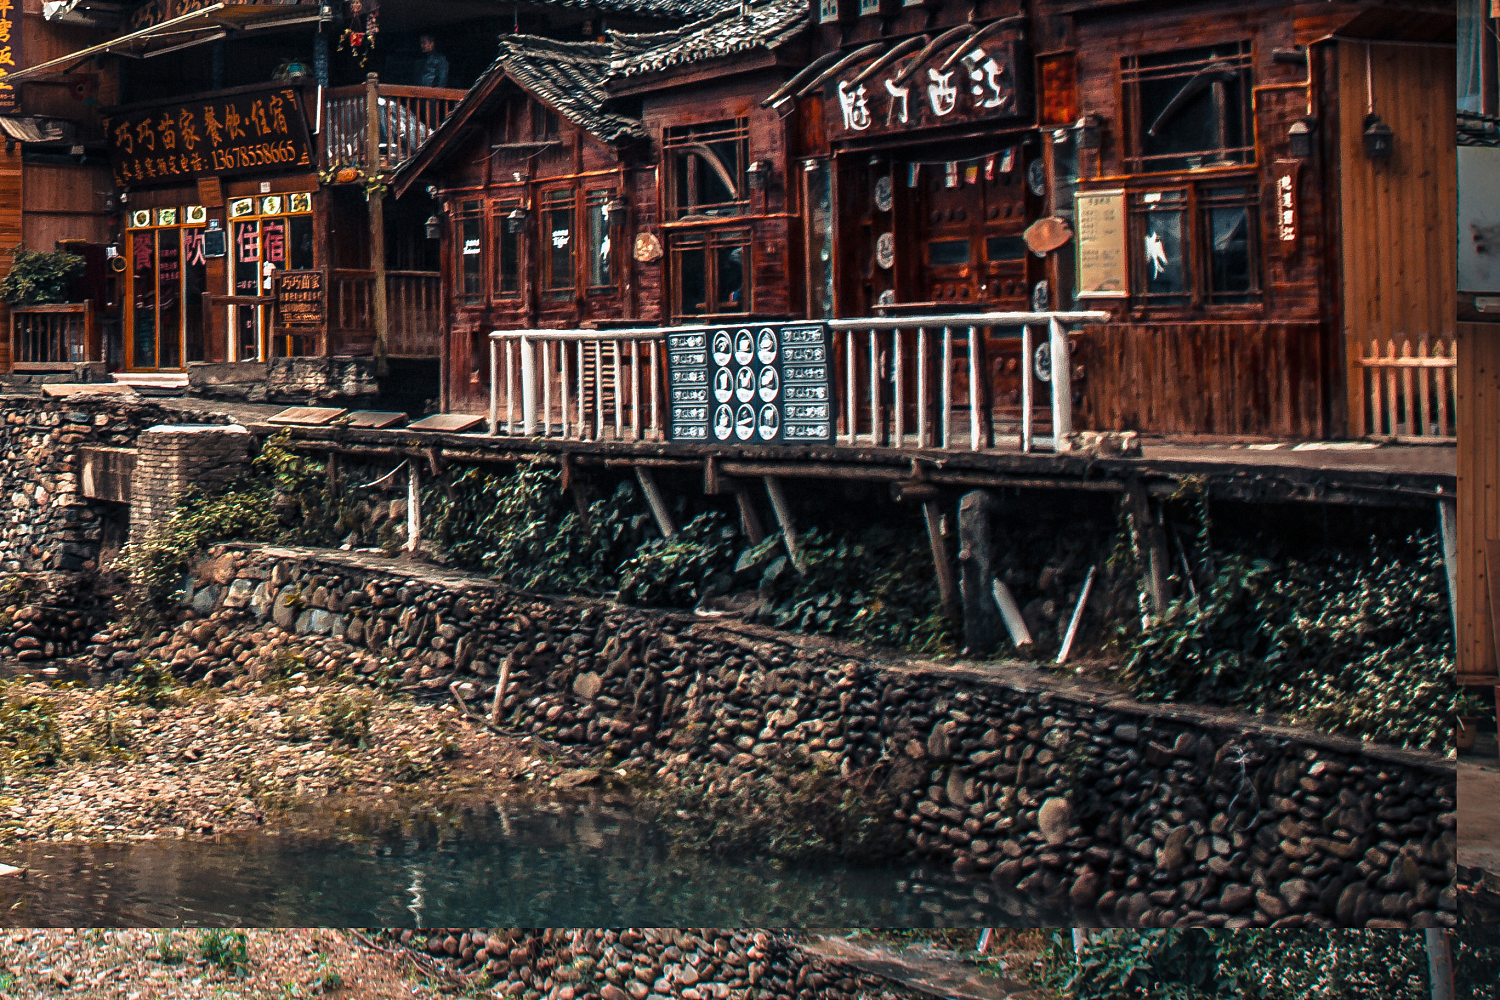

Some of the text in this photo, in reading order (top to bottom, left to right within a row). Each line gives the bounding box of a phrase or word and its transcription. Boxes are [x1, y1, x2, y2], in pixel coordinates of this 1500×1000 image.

[115, 108, 201, 153] 巧巧苗家
[211, 140, 296, 170] 13678558665
